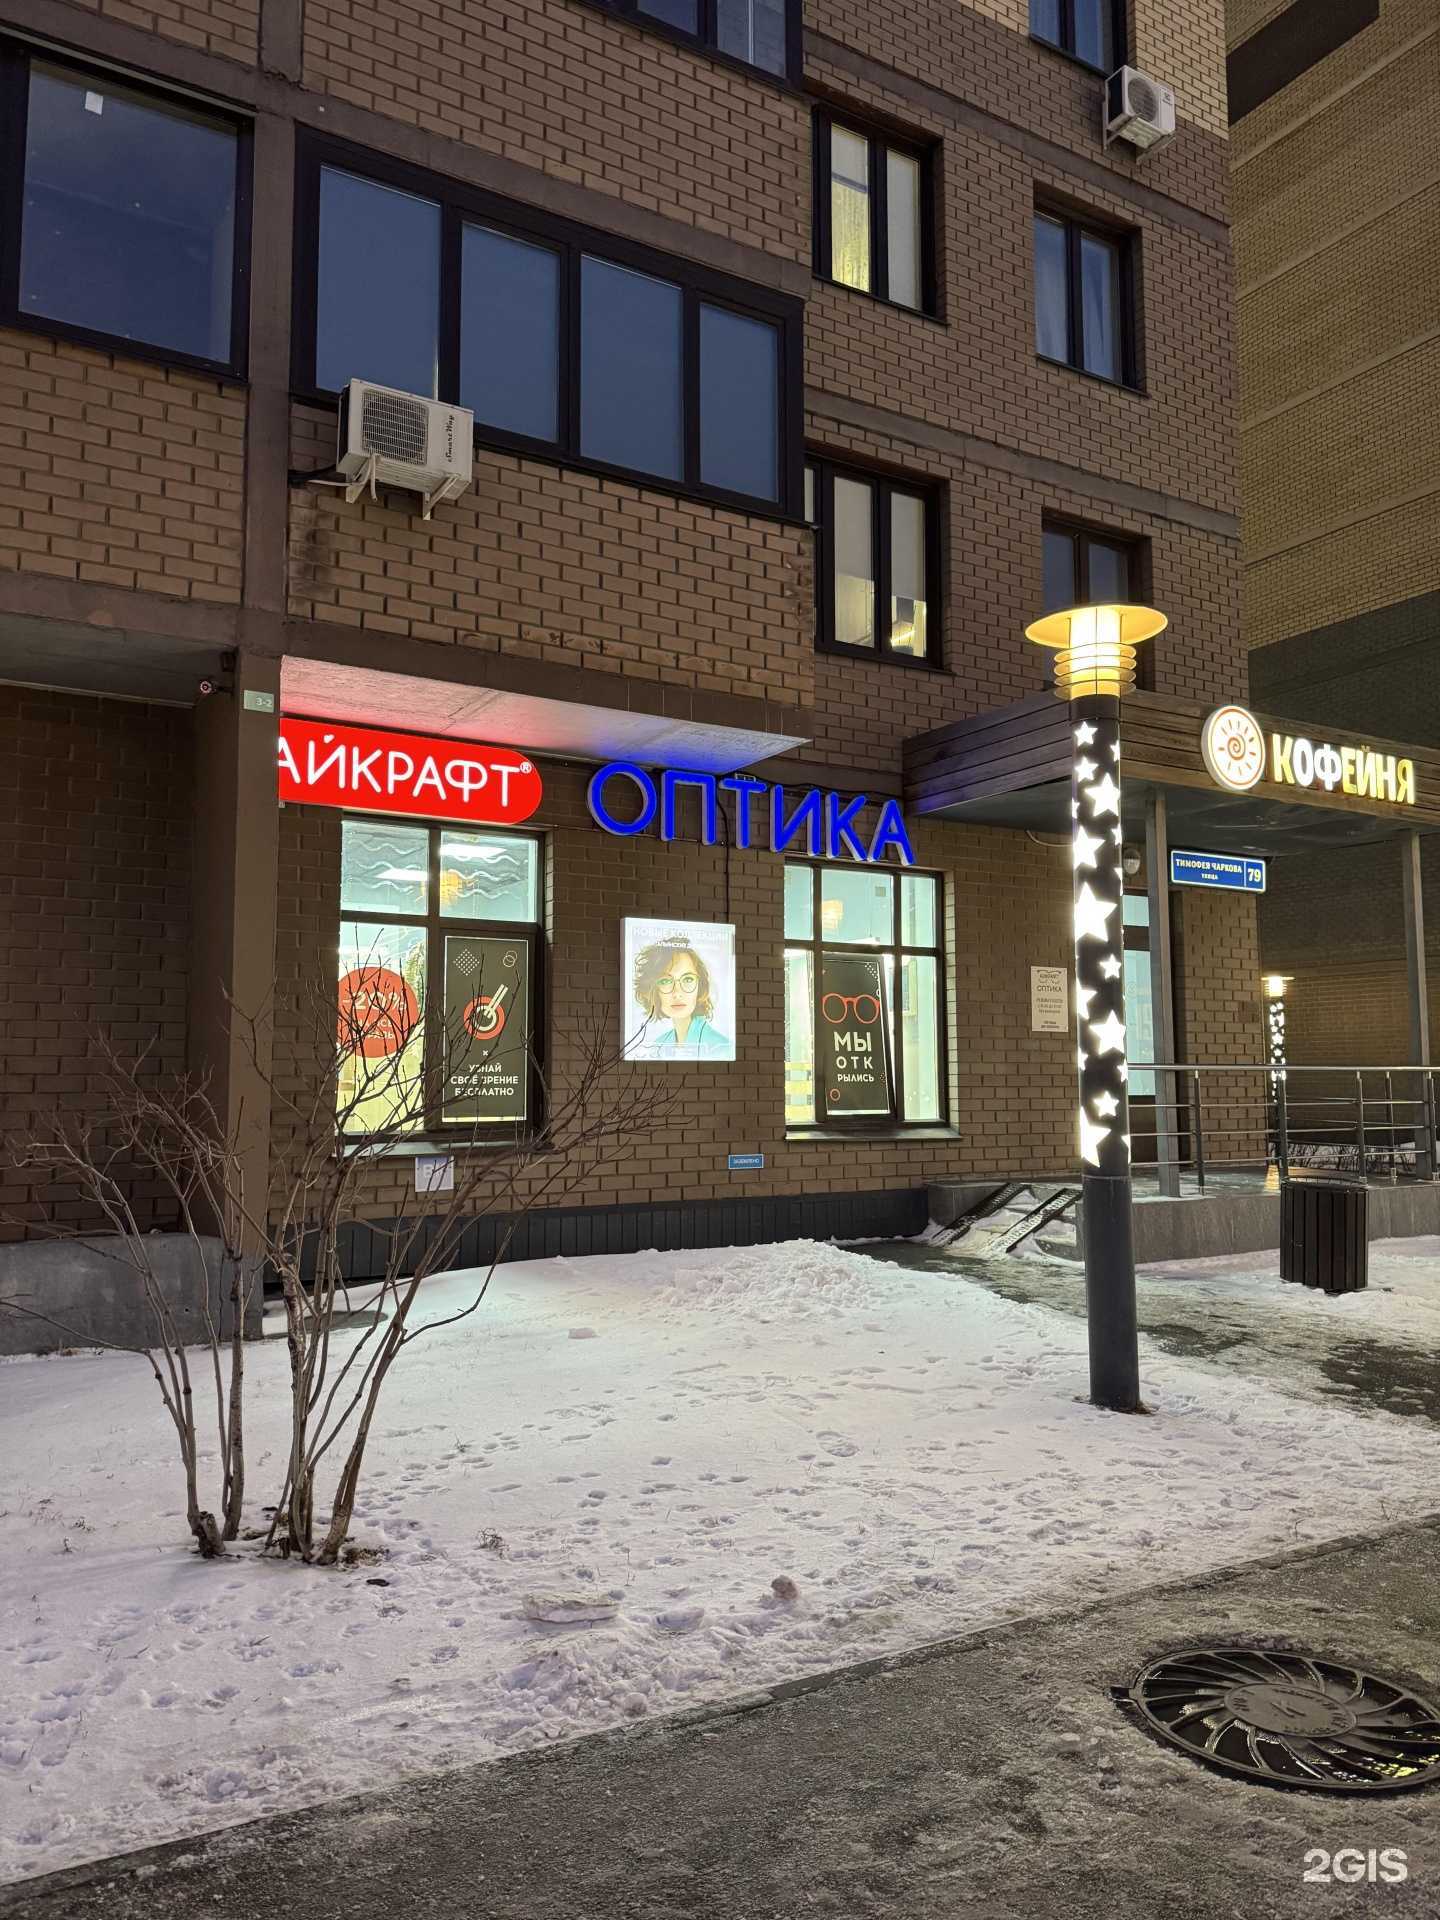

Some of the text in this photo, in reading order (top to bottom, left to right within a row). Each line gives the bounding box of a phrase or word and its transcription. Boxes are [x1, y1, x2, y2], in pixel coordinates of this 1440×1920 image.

[1272, 733, 1415, 805] КОФЕЙНЯ
[587, 761, 915, 866] ОПТИКА
[1247, 868, 1262, 882] 79
[833, 1031, 872, 1052] МЫ
[837, 1073, 875, 1082] РЫЛИСЬ
